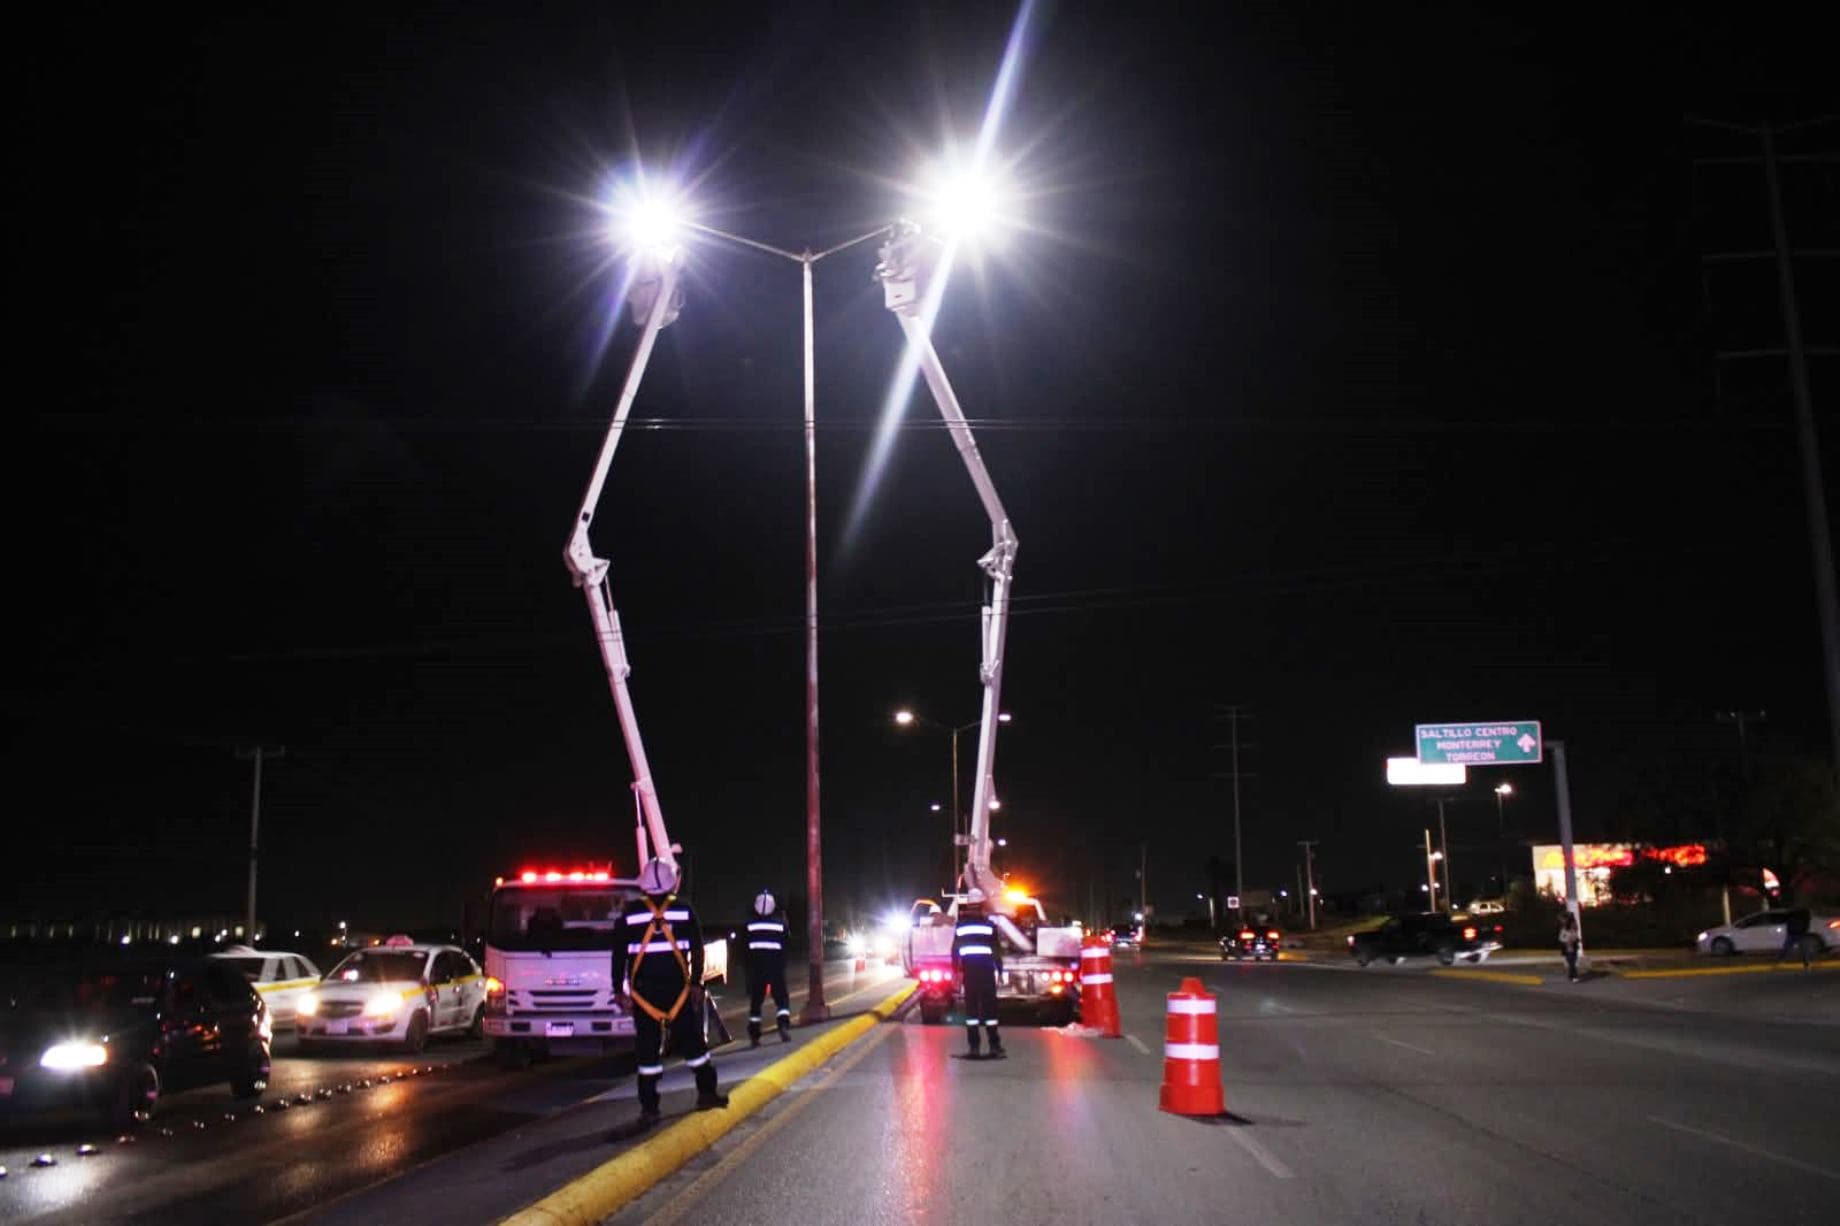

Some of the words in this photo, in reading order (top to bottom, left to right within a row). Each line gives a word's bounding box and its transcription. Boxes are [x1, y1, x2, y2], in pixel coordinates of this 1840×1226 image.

[1420, 728, 1472, 738] SALTILLO
[1475, 727, 1518, 737] CENTRO
[1436, 739, 1502, 750] MONTERREY
